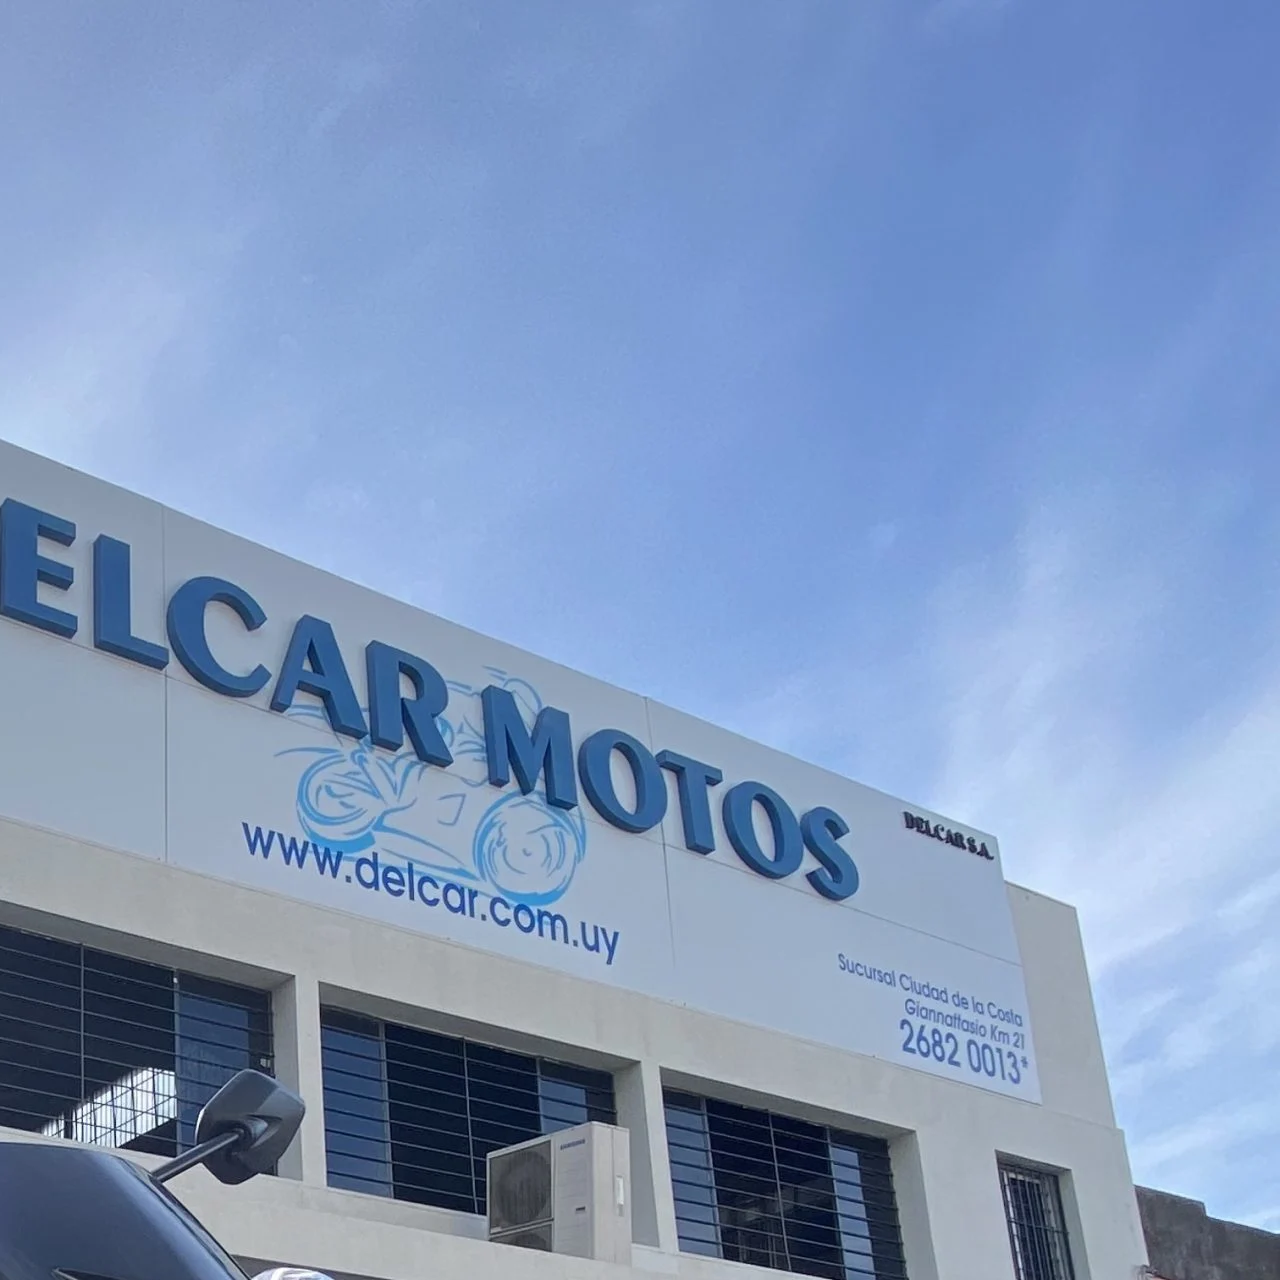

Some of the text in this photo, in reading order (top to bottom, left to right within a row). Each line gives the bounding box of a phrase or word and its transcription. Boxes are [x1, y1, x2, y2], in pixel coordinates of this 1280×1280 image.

[481, 684, 860, 901] MOTOS
[241, 819, 620, 967] www.delcar.com.uy
[838, 953, 1023, 1028] Sucursal Ciudad de la Costa
[904, 998, 1025, 1050] Giannattasio Km 21
[899, 1019, 962, 1069] 2682
